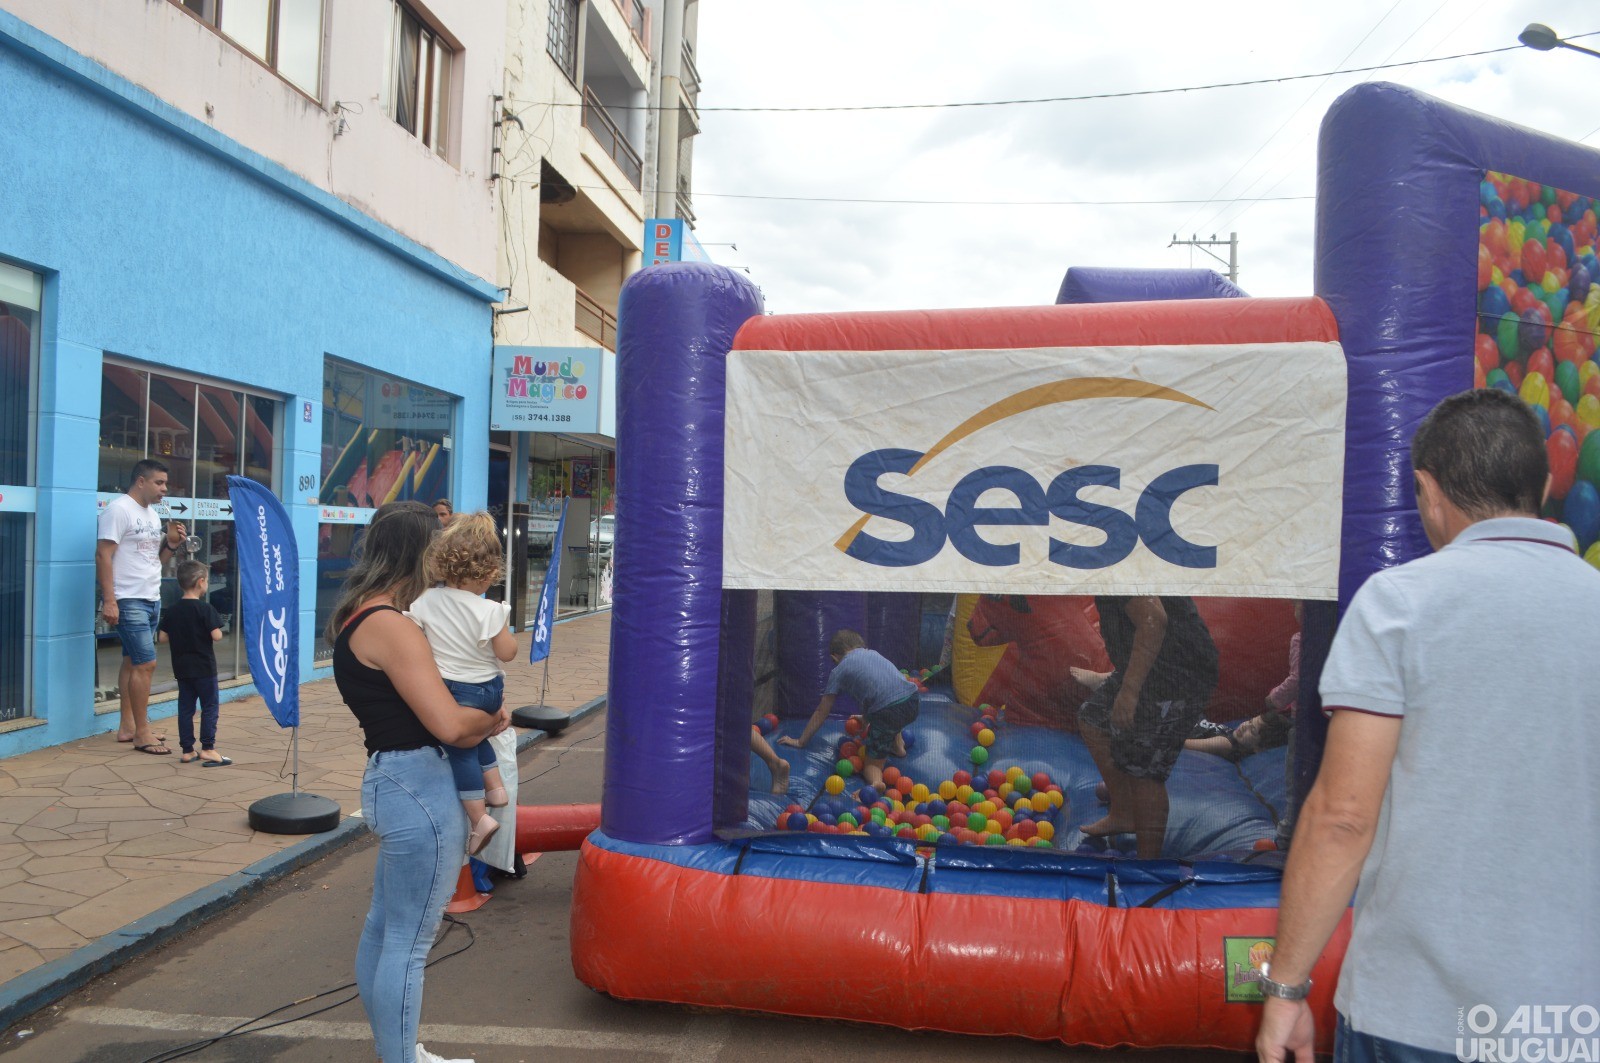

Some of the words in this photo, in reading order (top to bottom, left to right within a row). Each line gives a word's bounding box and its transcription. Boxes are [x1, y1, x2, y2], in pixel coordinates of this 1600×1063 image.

[654, 223, 672, 266] DE
[511, 354, 586, 377] Mundo
[507, 376, 588, 404] Mágico
[528, 413, 571, 422] 3744.1388
[298, 474, 315, 492] 890
[197, 501, 219, 509] ENTRADA
[842, 446, 1220, 570] Sesc
